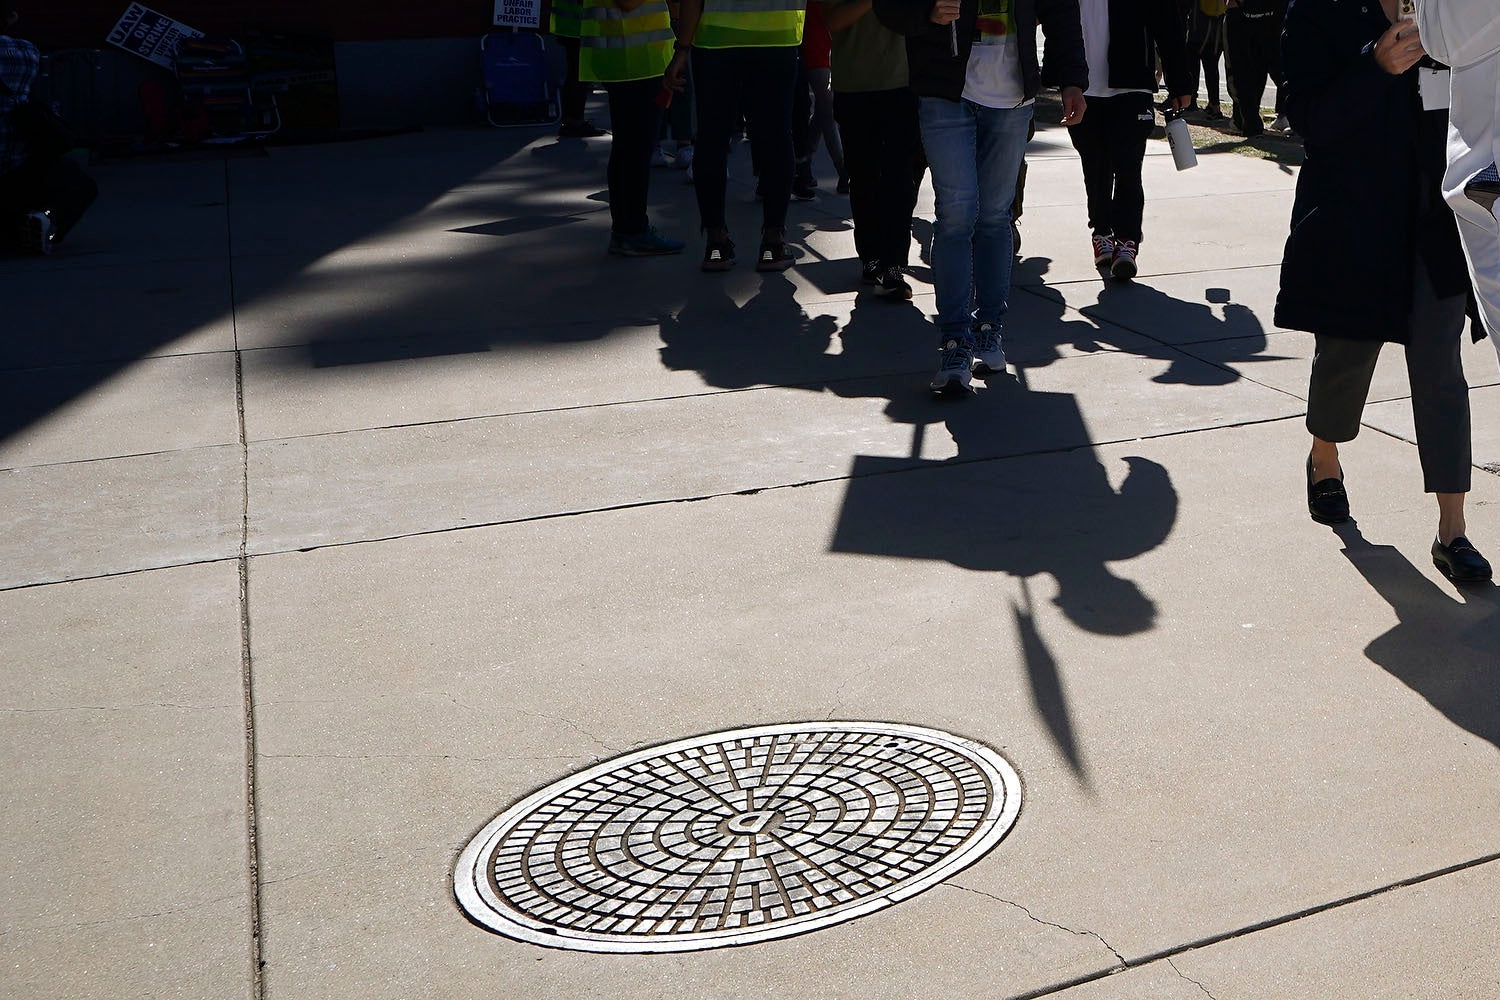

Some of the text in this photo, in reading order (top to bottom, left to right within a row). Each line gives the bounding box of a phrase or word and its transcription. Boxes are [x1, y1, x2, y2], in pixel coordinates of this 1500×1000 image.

[503, 0, 533, 8] UNFAIR
[504, 7, 531, 15] LABOR
[497, 15, 537, 25] PRACTICE
